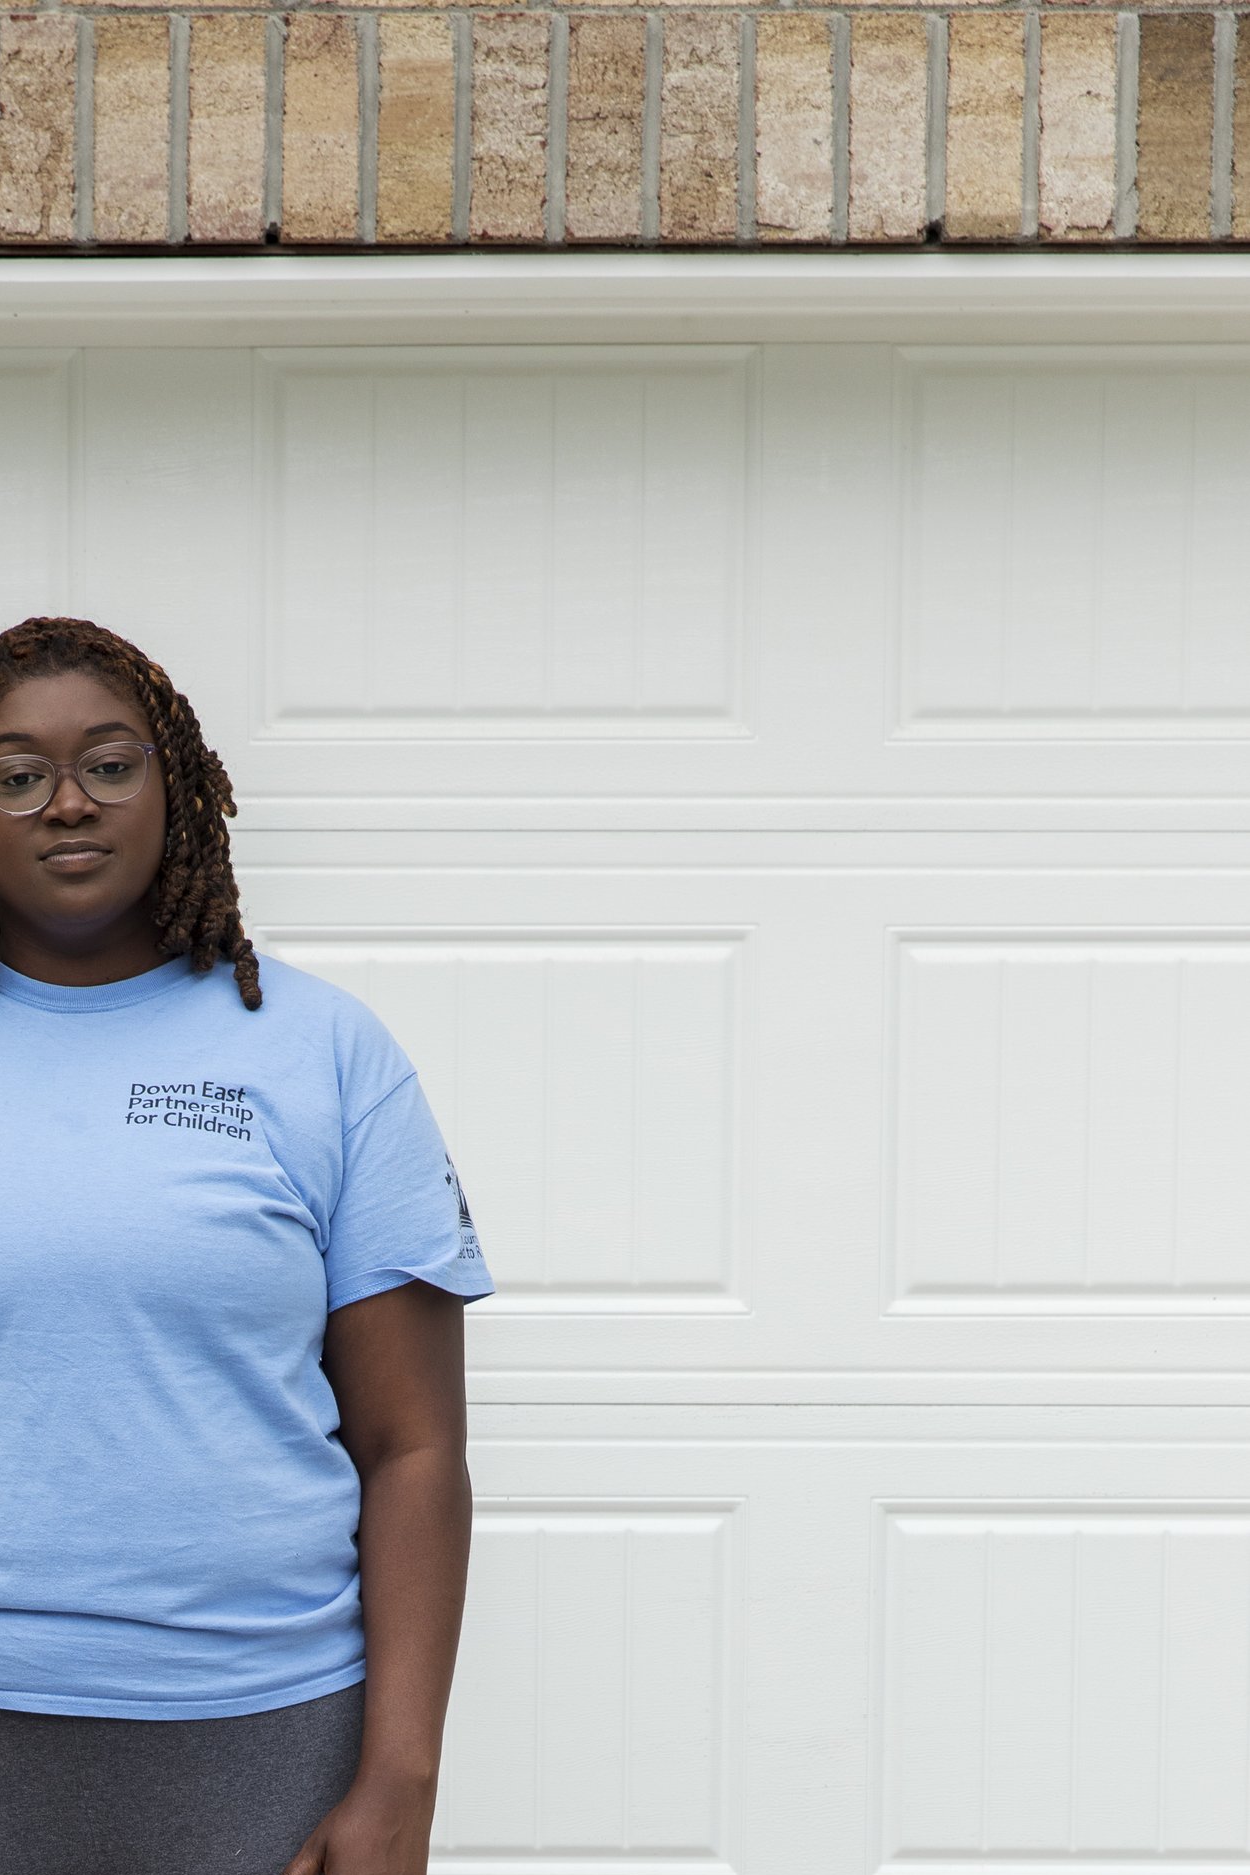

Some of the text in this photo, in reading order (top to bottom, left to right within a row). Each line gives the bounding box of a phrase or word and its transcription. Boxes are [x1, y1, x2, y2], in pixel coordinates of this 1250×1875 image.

[130, 1081, 247, 1103] Down East
[128, 1096, 254, 1124] Partnership
[124, 1111, 251, 1142] for Children
